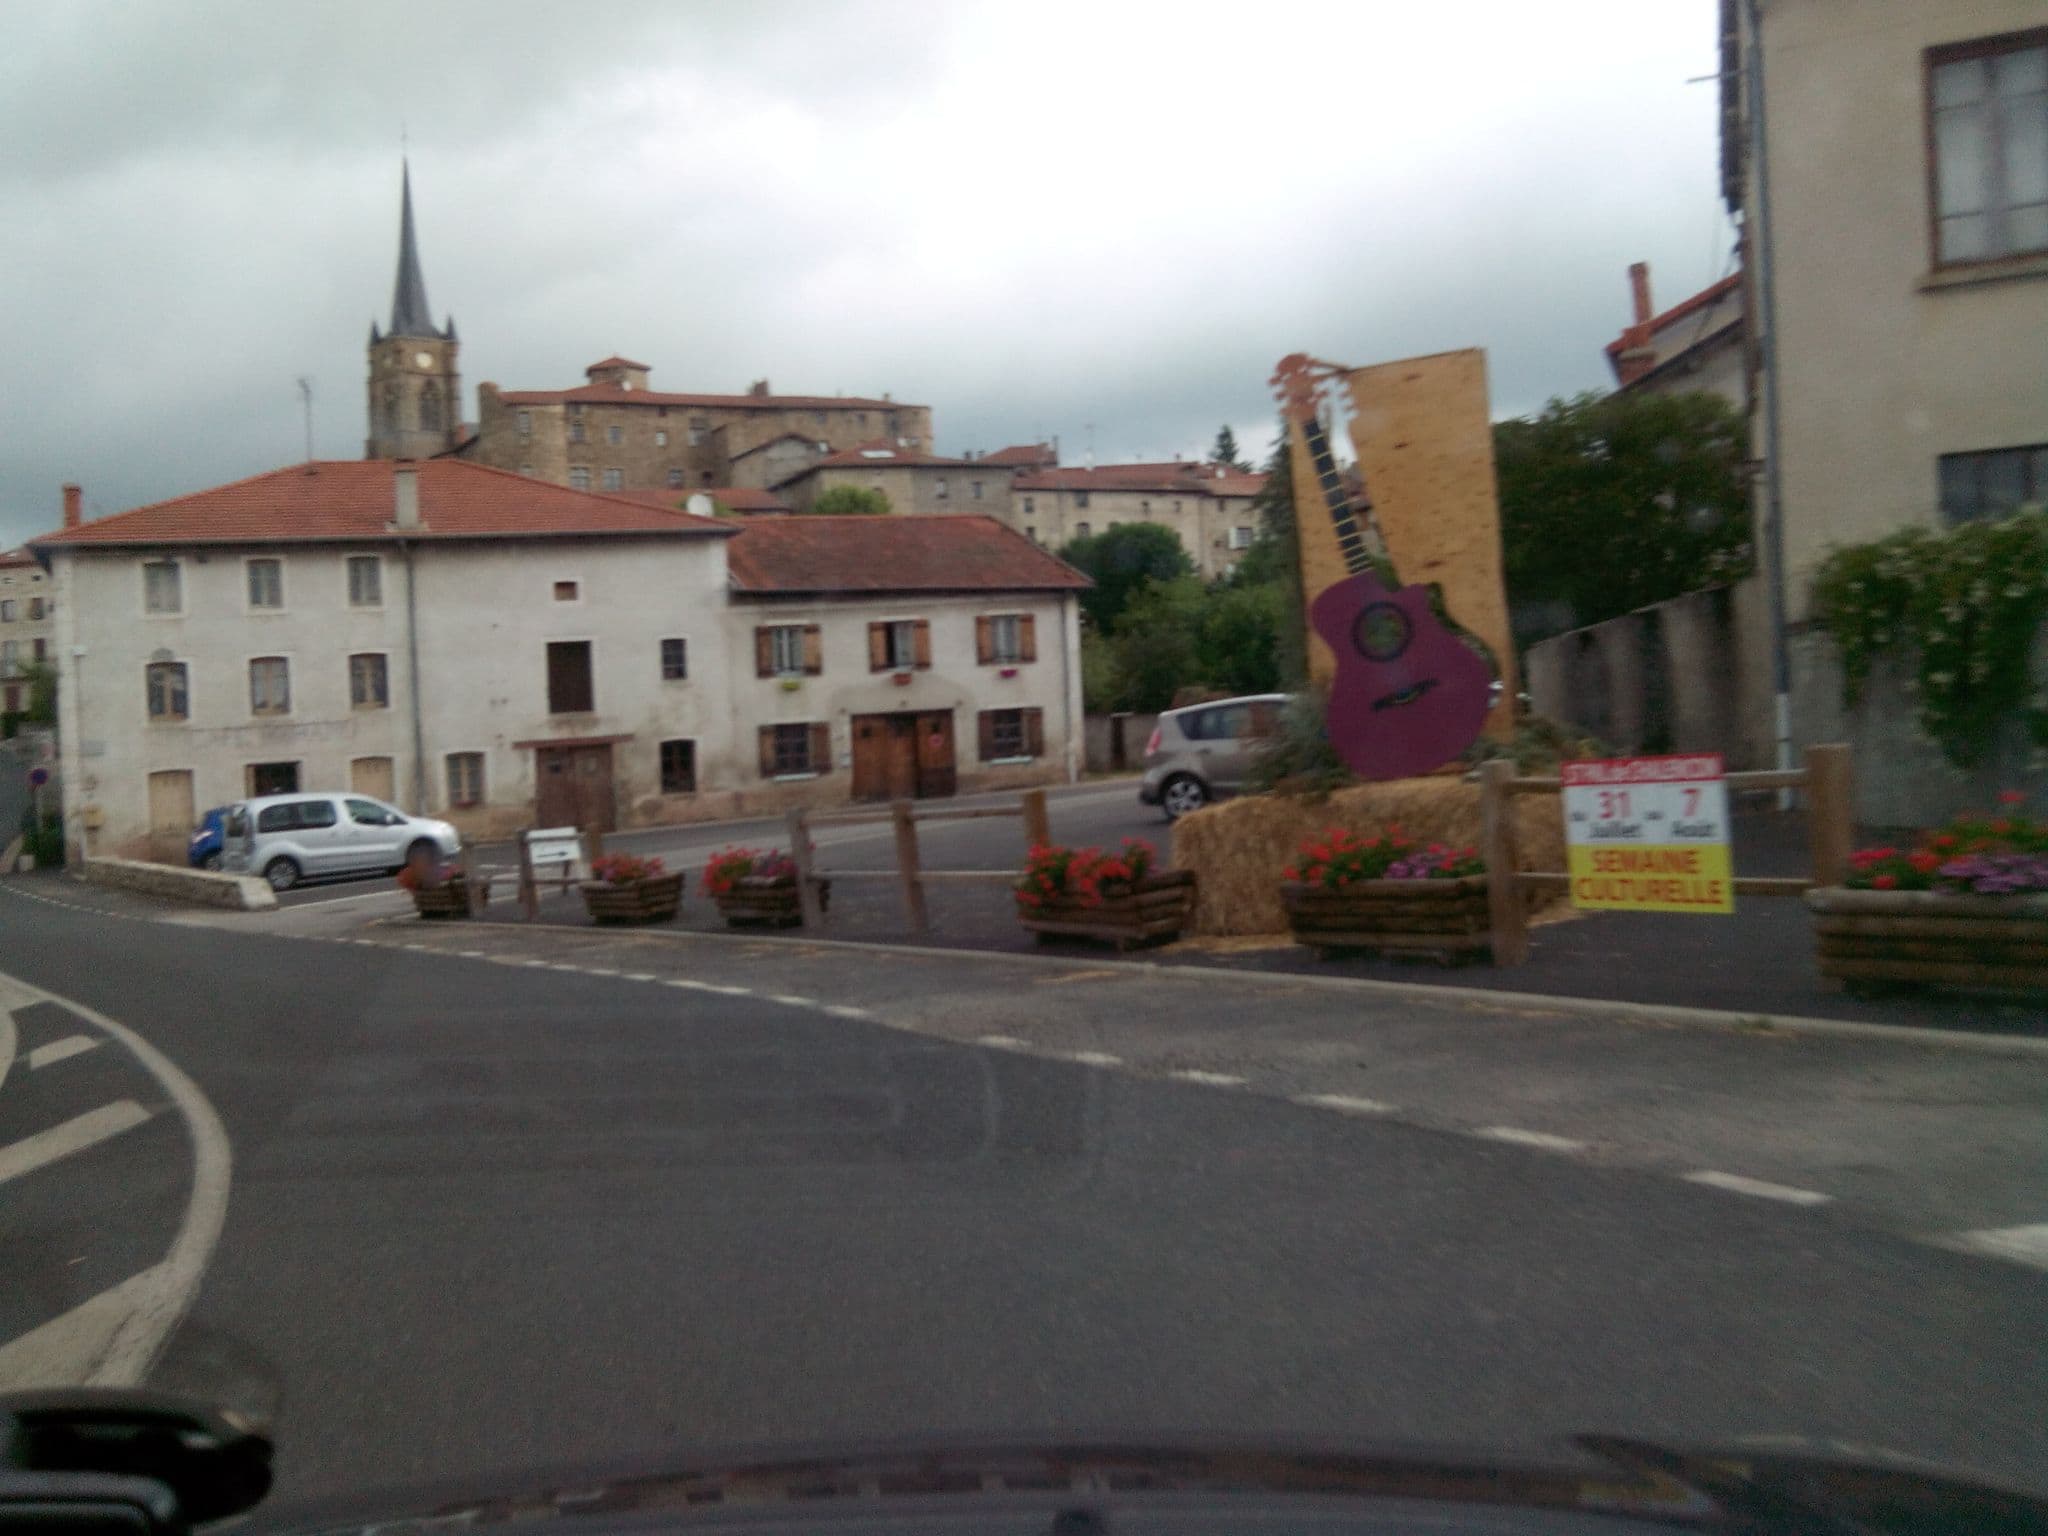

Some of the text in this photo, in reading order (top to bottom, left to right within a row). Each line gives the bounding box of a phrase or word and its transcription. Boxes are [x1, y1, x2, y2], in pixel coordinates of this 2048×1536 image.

[1597, 788, 1701, 819] 31 7
[1592, 849, 1700, 874] SEMAINE
[1576, 878, 1724, 905] CULTURELLE
